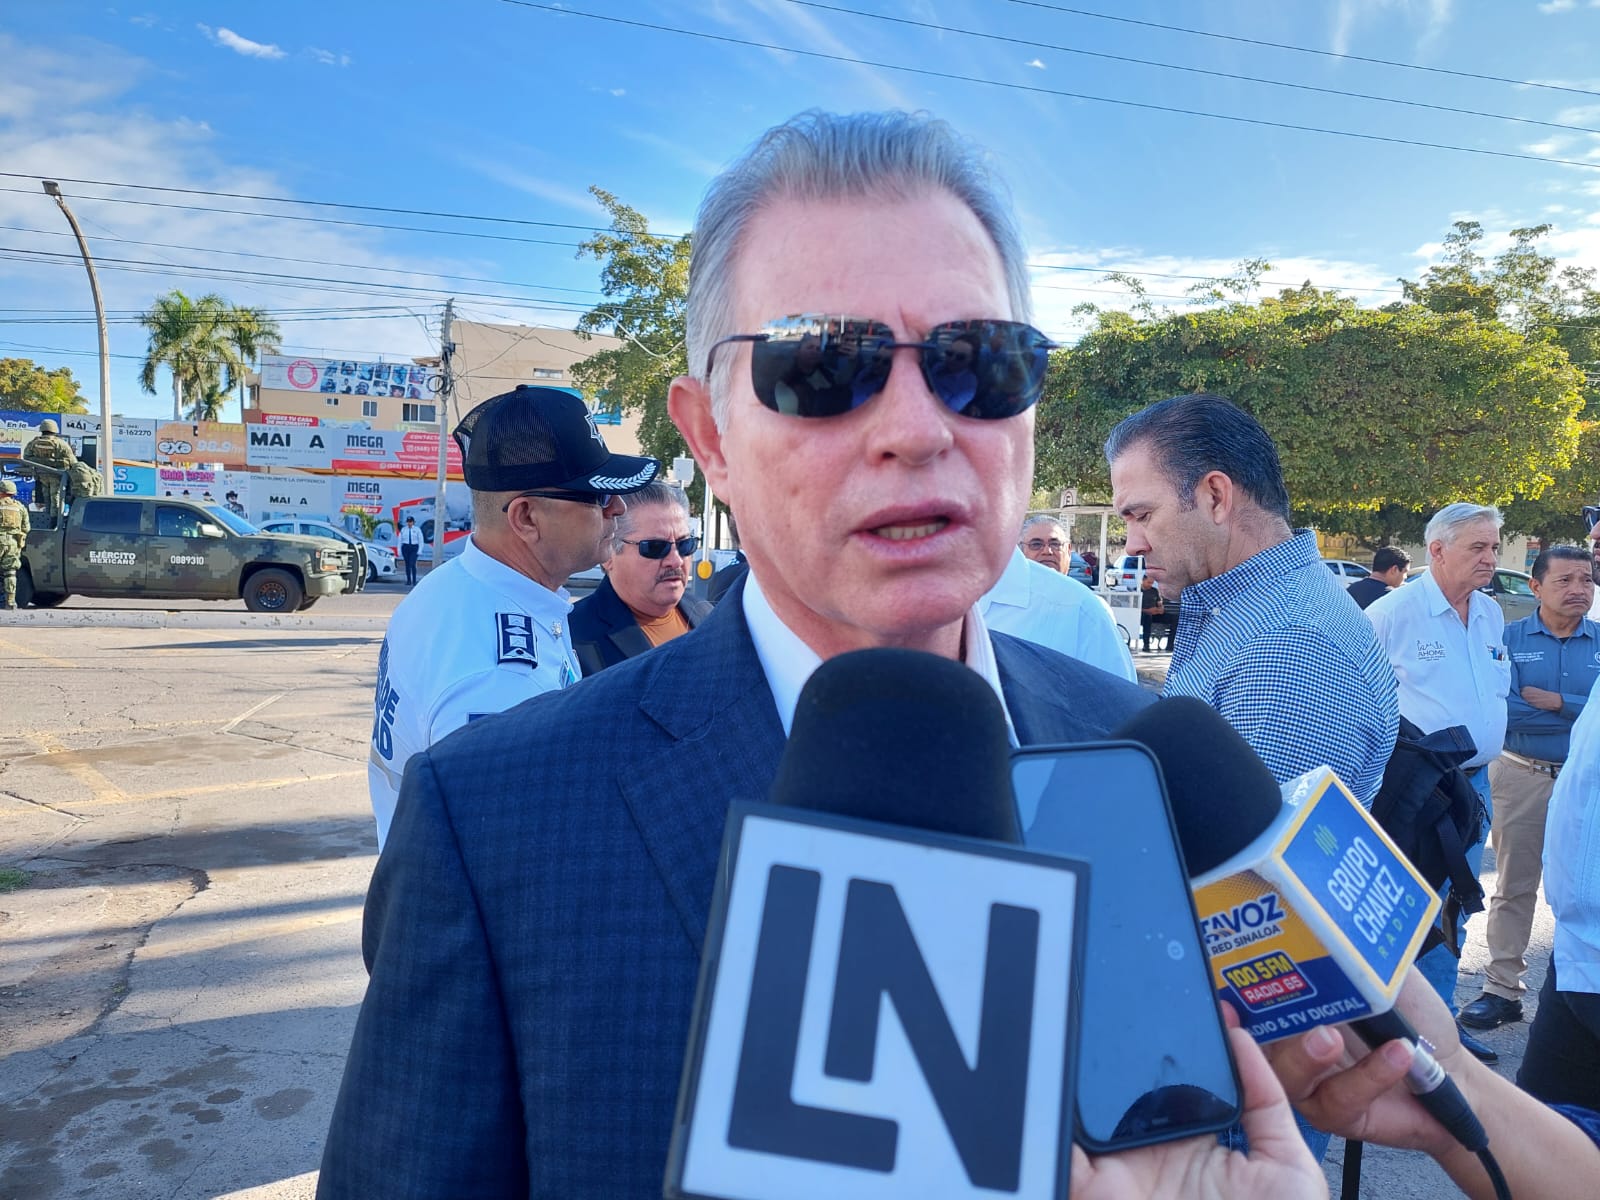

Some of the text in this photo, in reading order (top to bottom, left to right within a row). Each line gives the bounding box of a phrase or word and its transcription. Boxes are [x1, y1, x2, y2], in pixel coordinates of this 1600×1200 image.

[347, 434, 384, 448] MEGA
[347, 482, 380, 493] MEGA
[89, 550, 136, 560] EJÉRCITO
[1327, 836, 1379, 912] GRUPO
[1353, 864, 1405, 945] CHAVEZ
[1211, 924, 1281, 955] RED SINALOA
[1378, 894, 1416, 959] RADIO
[1244, 975, 1304, 1002] RADIO 65
[1277, 1016, 1290, 1029] &
[1287, 1011, 1308, 1025] TV
[1306, 997, 1365, 1021] DIGITAL
[727, 864, 1040, 1194] LN
